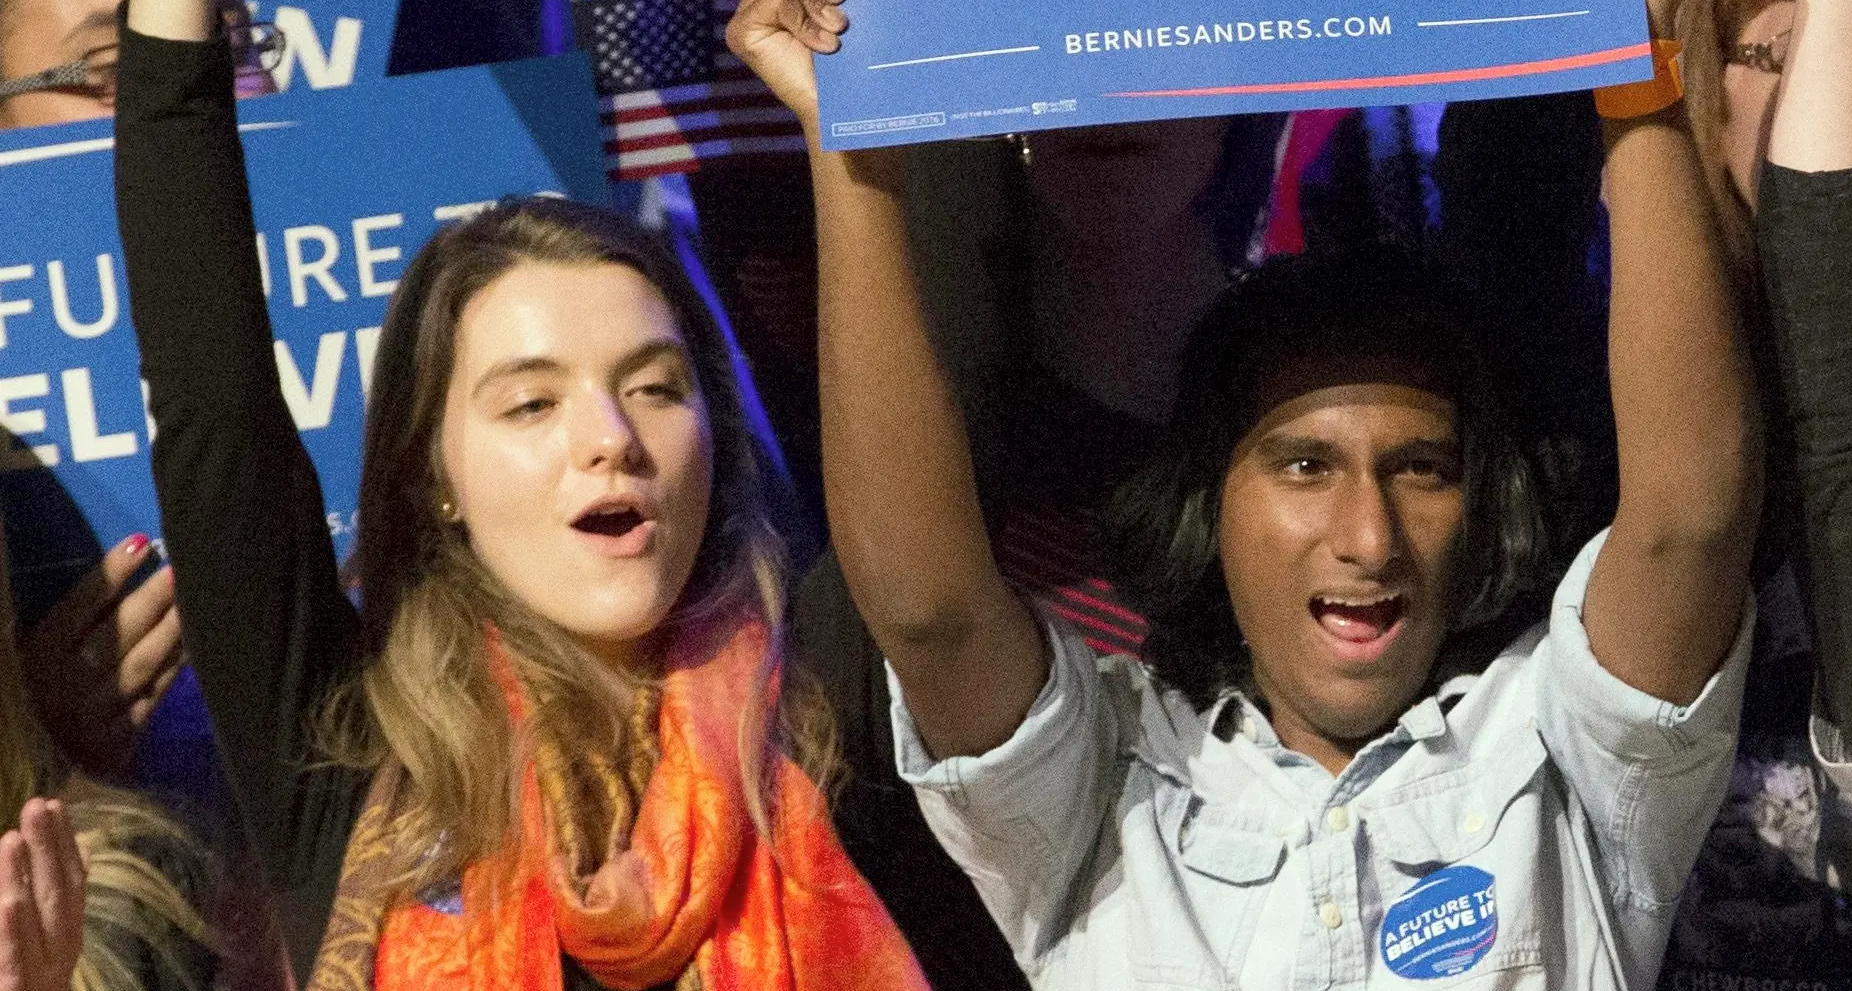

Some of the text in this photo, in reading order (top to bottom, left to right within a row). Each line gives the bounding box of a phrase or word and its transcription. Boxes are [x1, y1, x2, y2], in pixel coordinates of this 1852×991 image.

[247, 0, 363, 94] N
[1065, 14, 1392, 55] BERNIESANDERS.COM
[1386, 932, 1399, 947] A
[1399, 895, 1471, 937] FUTURE
[1386, 909, 1477, 962] BELIEVE
